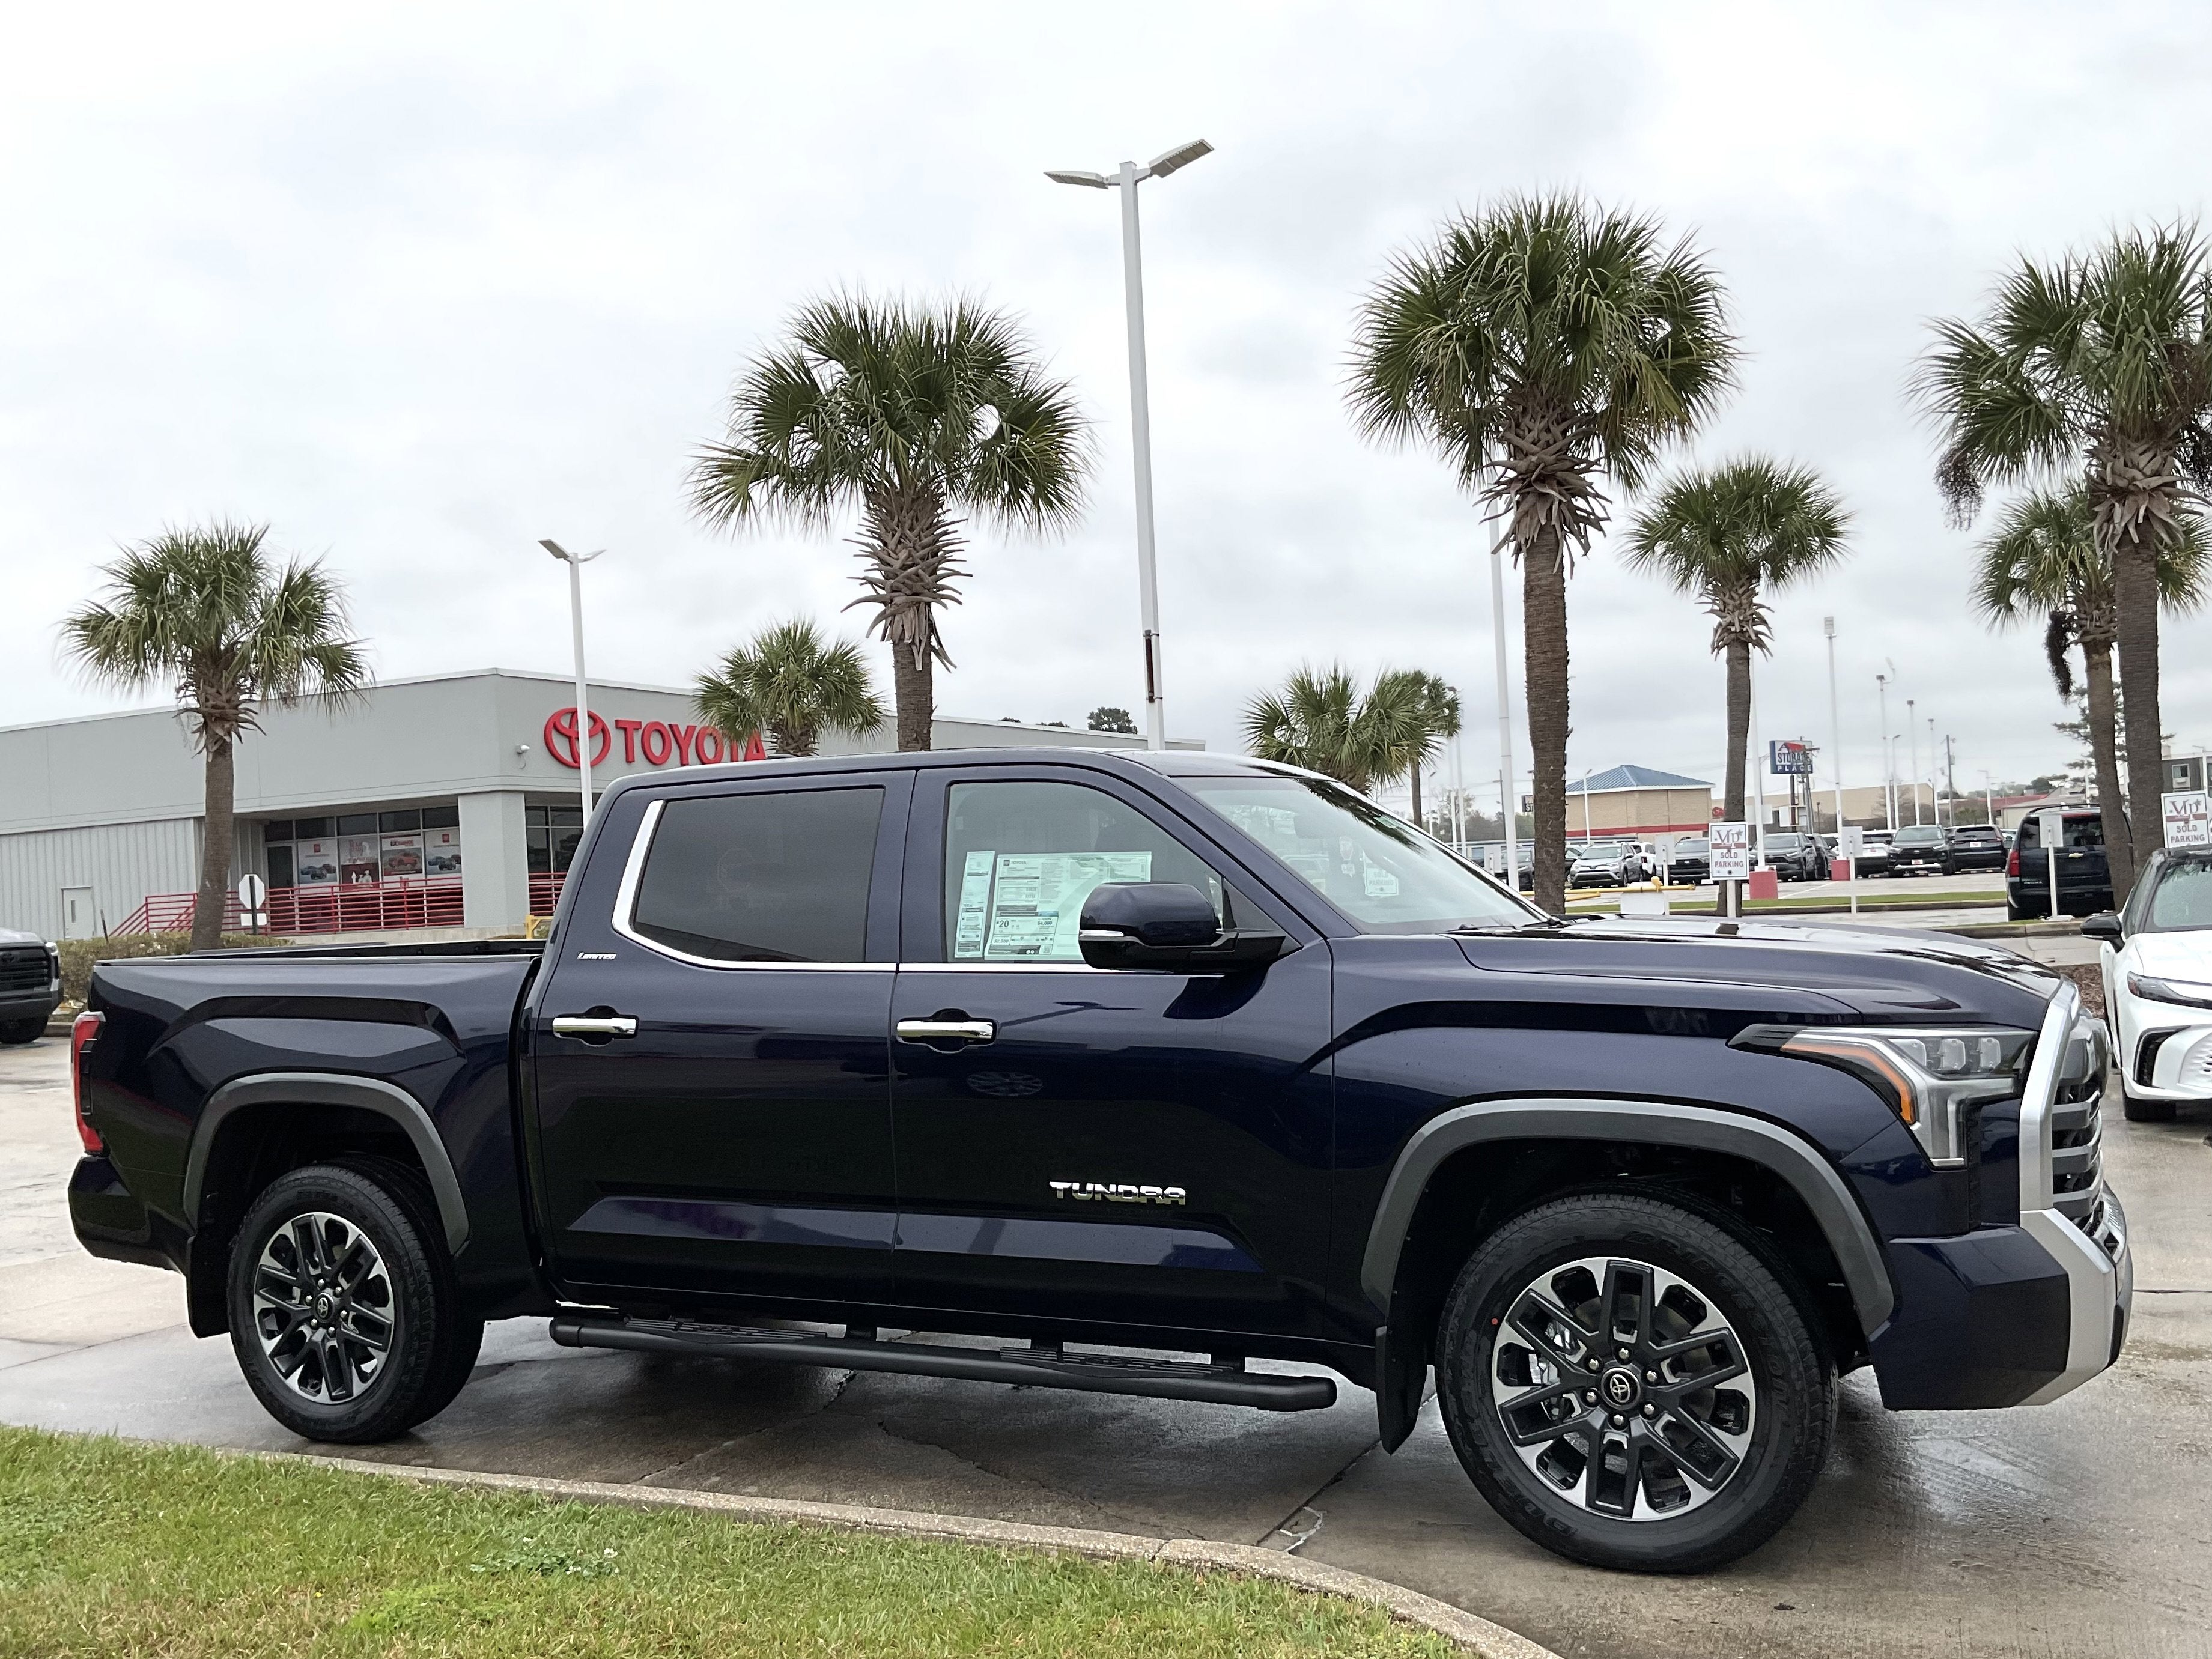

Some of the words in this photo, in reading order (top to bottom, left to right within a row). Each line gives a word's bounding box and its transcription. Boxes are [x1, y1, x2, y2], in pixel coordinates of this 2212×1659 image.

[2177, 825, 2197, 833] SOLD
[2170, 834, 2205, 843] PARKING
[1049, 1181, 1186, 1206] TUNDRA
